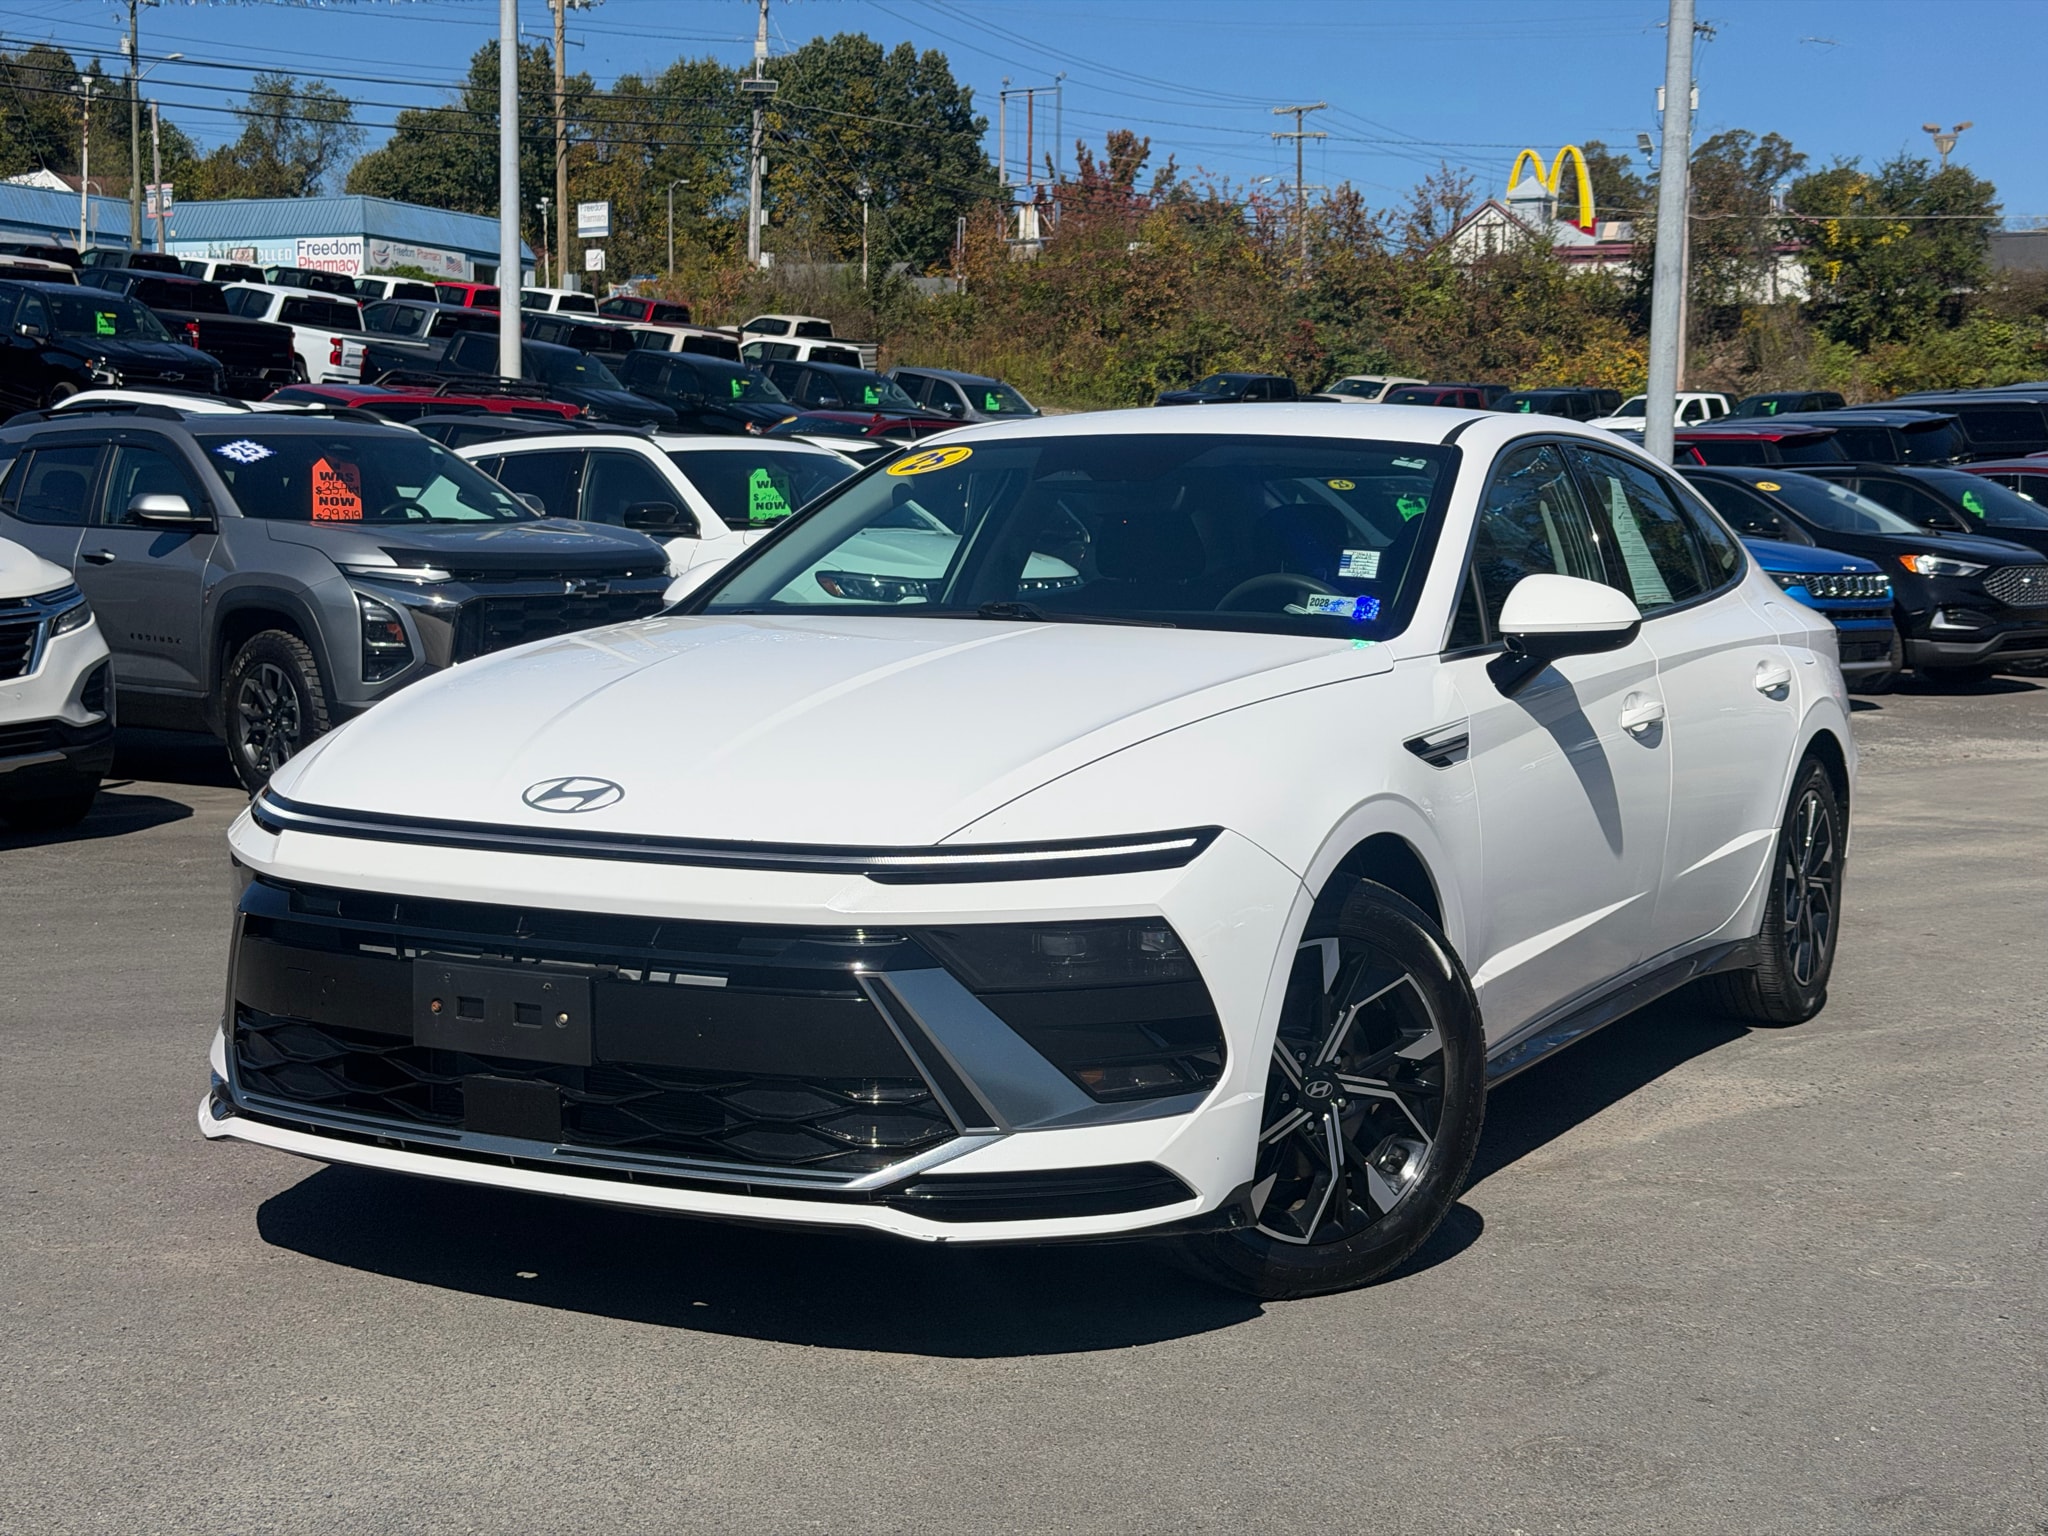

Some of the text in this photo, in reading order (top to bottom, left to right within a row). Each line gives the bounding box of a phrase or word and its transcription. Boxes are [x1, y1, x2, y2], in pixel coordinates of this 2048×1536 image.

[297, 240, 362, 256] Freedom
[298, 257, 360, 275] Pharmacy
[319, 472, 354, 482] WAS
[319, 496, 355, 507] NOW
[755, 502, 786, 510] NOW
[1309, 597, 1329, 607] 2028
